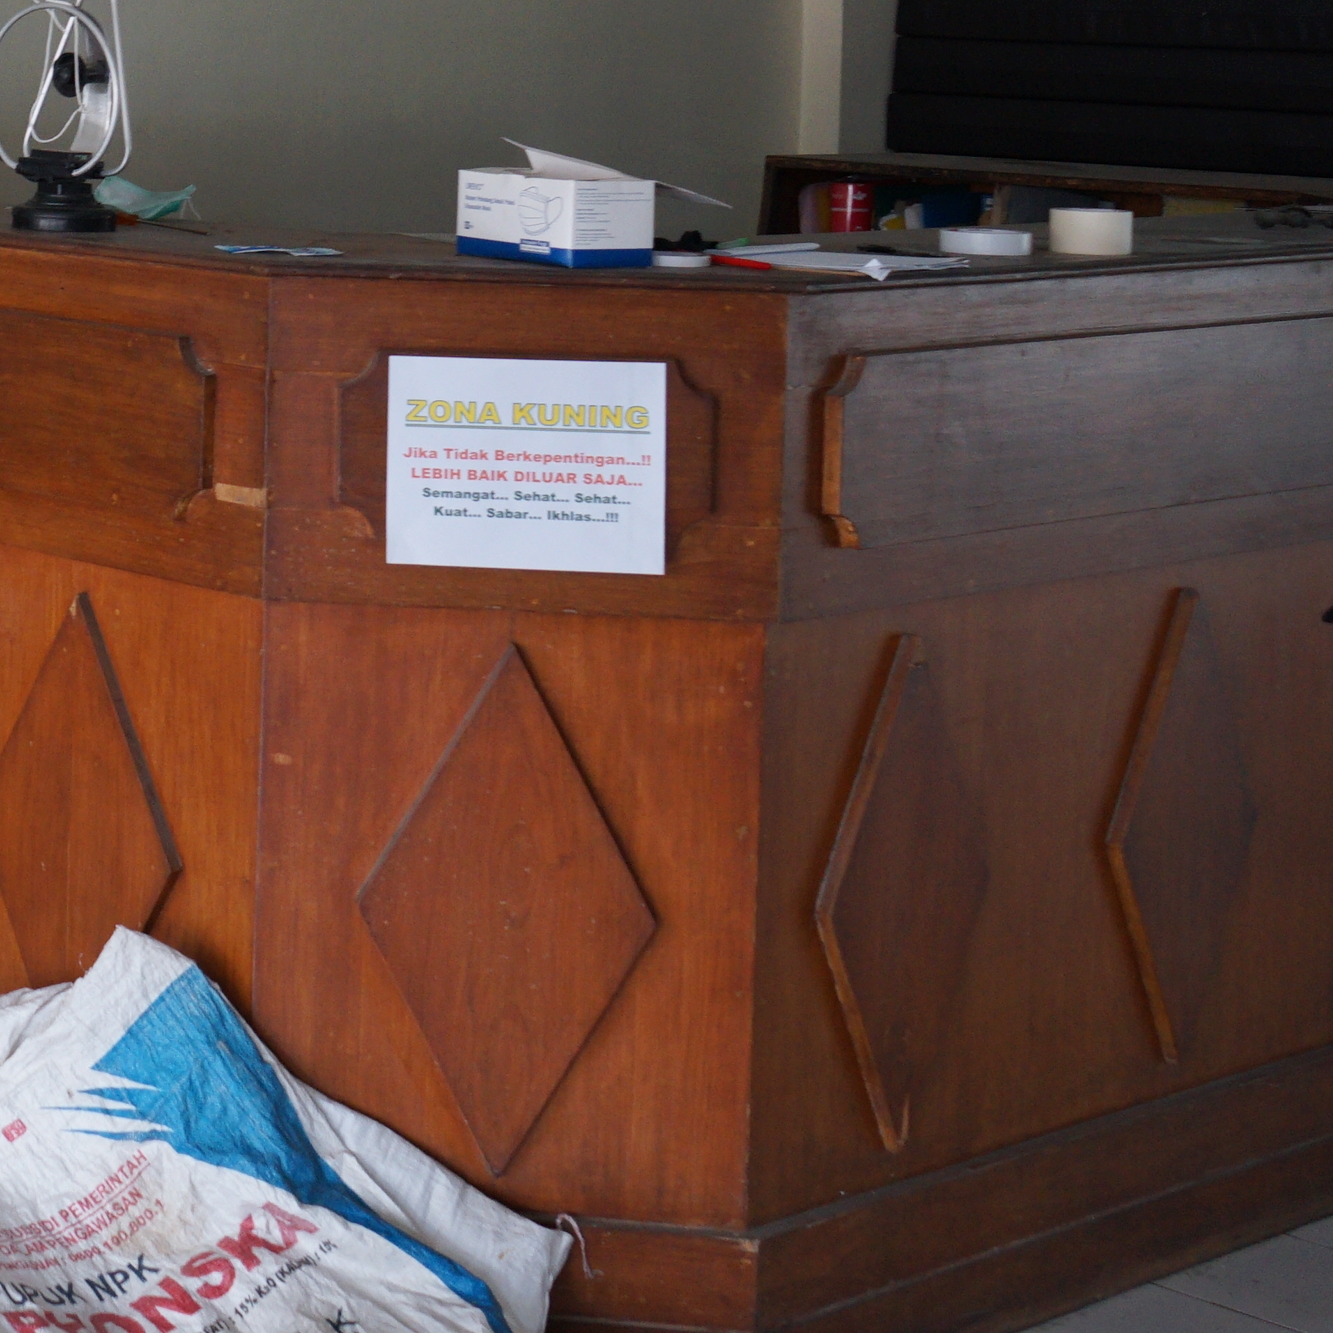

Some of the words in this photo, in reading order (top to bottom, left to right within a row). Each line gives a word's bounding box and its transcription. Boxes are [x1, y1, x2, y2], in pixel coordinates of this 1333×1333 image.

[405, 399, 502, 425] ZONA
[513, 402, 650, 430] KUNING
[403, 447, 438, 460] Jika
[444, 448, 489, 462] Tidak
[411, 467, 462, 481] LEBIH
[467, 469, 509, 482] BAIK
[514, 470, 578, 485] DILUAR
[58, 1149, 148, 1223] PEMERINTAH
[45, 1187, 144, 1251] PENGAWASAN
[85, 1253, 162, 1302] NPK
